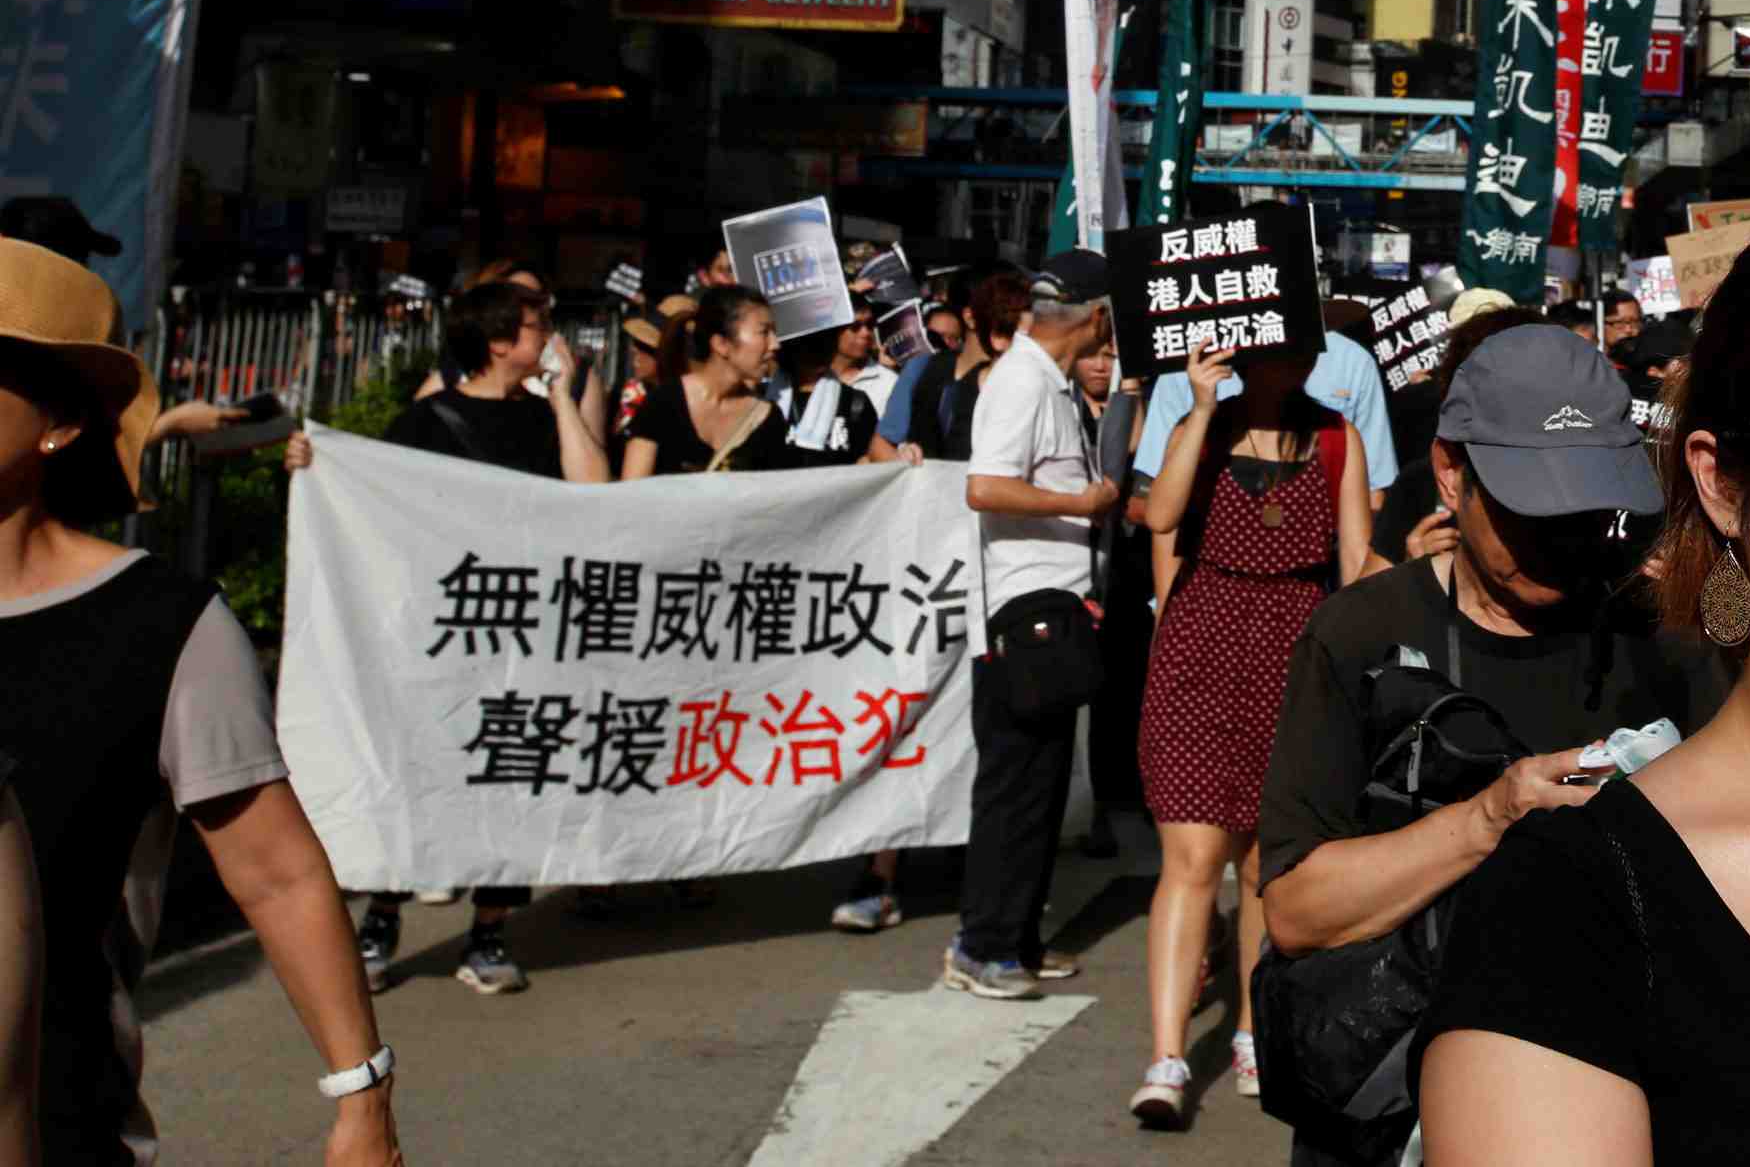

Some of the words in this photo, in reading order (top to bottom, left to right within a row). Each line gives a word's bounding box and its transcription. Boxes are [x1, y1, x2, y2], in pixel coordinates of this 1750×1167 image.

[1160, 218, 1260, 263] 反威權
[1147, 263, 1281, 312] 港人自救
[1152, 310, 1286, 359] 拒絕沉淪
[427, 551, 970, 664] 無懼威權政治
[463, 688, 931, 797] 聲援政治犯
